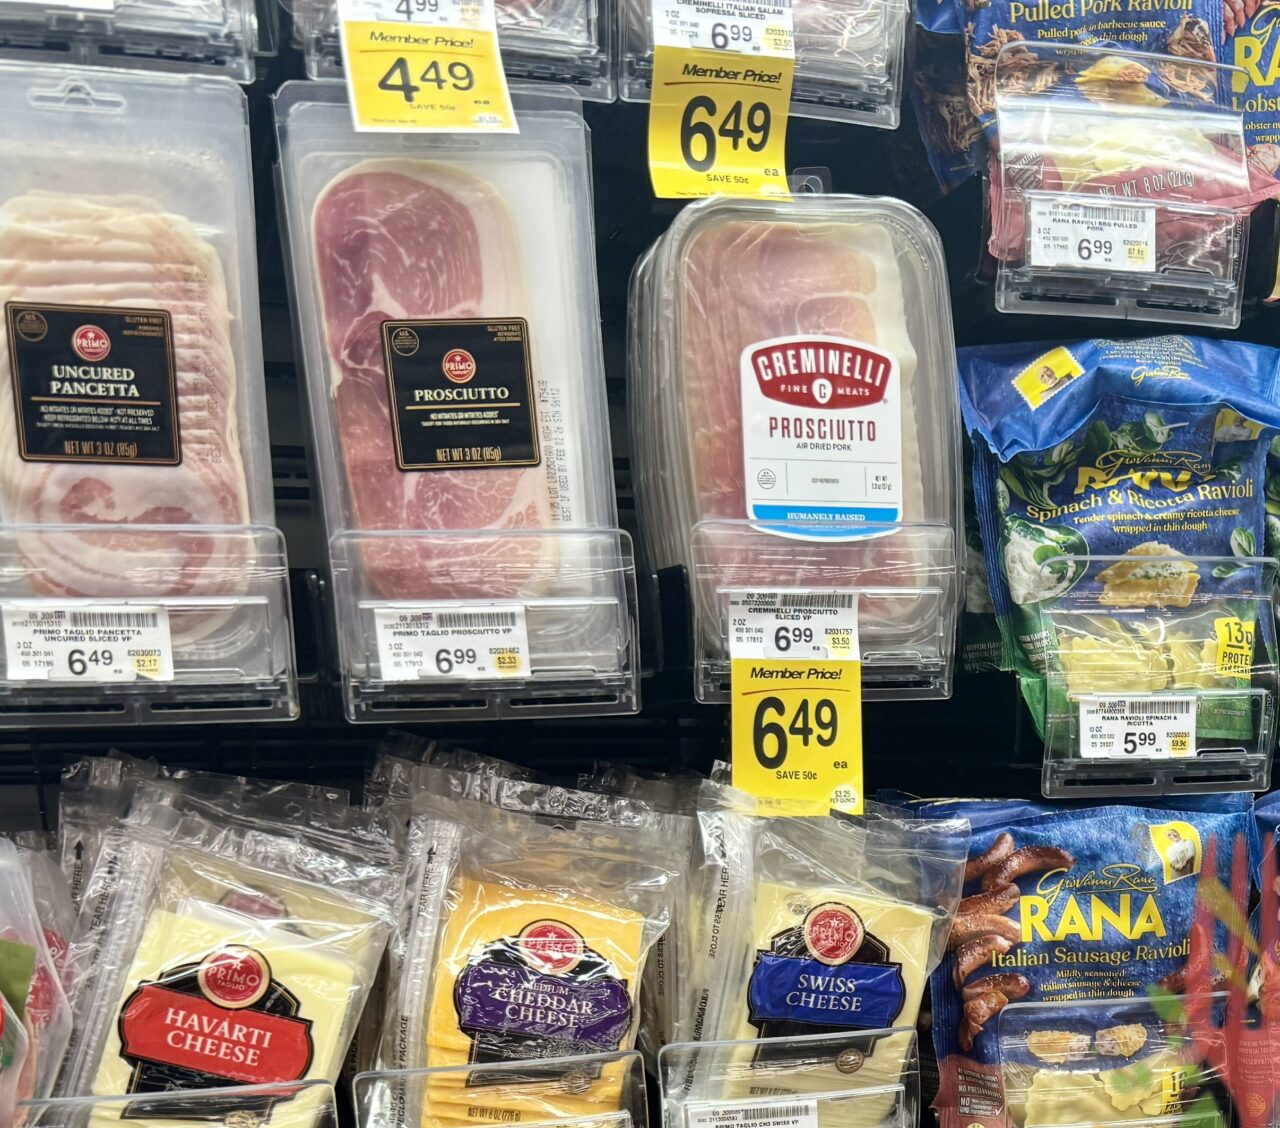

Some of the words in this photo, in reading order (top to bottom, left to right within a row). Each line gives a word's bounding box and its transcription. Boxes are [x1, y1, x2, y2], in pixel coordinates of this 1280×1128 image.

[370, 30, 431, 48] Member
[433, 33, 474, 49] Price!
[682, 63, 741, 81] Member
[743, 68, 781, 83] Price!
[706, 173, 731, 183] SAVE
[764, 168, 779, 176] ea
[52, 365, 134, 382] UNCURED
[757, 348, 885, 387] CREMINELLI
[51, 380, 140, 397] PANCETTA
[414, 386, 509, 401] PROSCIUTTO
[780, 384, 809, 395] FINE
[837, 386, 870, 397] MEATS
[769, 416, 876, 441] PROSCIUTTO
[809, 442, 831, 450] DRIED
[1026, 501, 1103, 522] Spinach
[1108, 493, 1120, 510] &
[1127, 488, 1192, 509] Ricotta
[1199, 480, 1253, 500] Ravioli
[750, 667, 805, 680] Member
[806, 668, 841, 680] Price!
[833, 759, 847, 769] ea
[776, 770, 800, 780] SAVE
[1020, 893, 1165, 942] RANA
[991, 951, 1048, 968] Italian
[1054, 948, 1129, 964] Sausage
[1136, 940, 1189, 958] Ravioli
[206, 965, 259, 986] PRIMO
[798, 974, 856, 993] SWISS
[498, 989, 593, 1014] CHEDDAR
[785, 992, 862, 1012] CHEESE
[504, 1005, 579, 1029] CHEESE
[164, 1008, 272, 1048] HAVARTI
[166, 1030, 260, 1067] CHEESE
